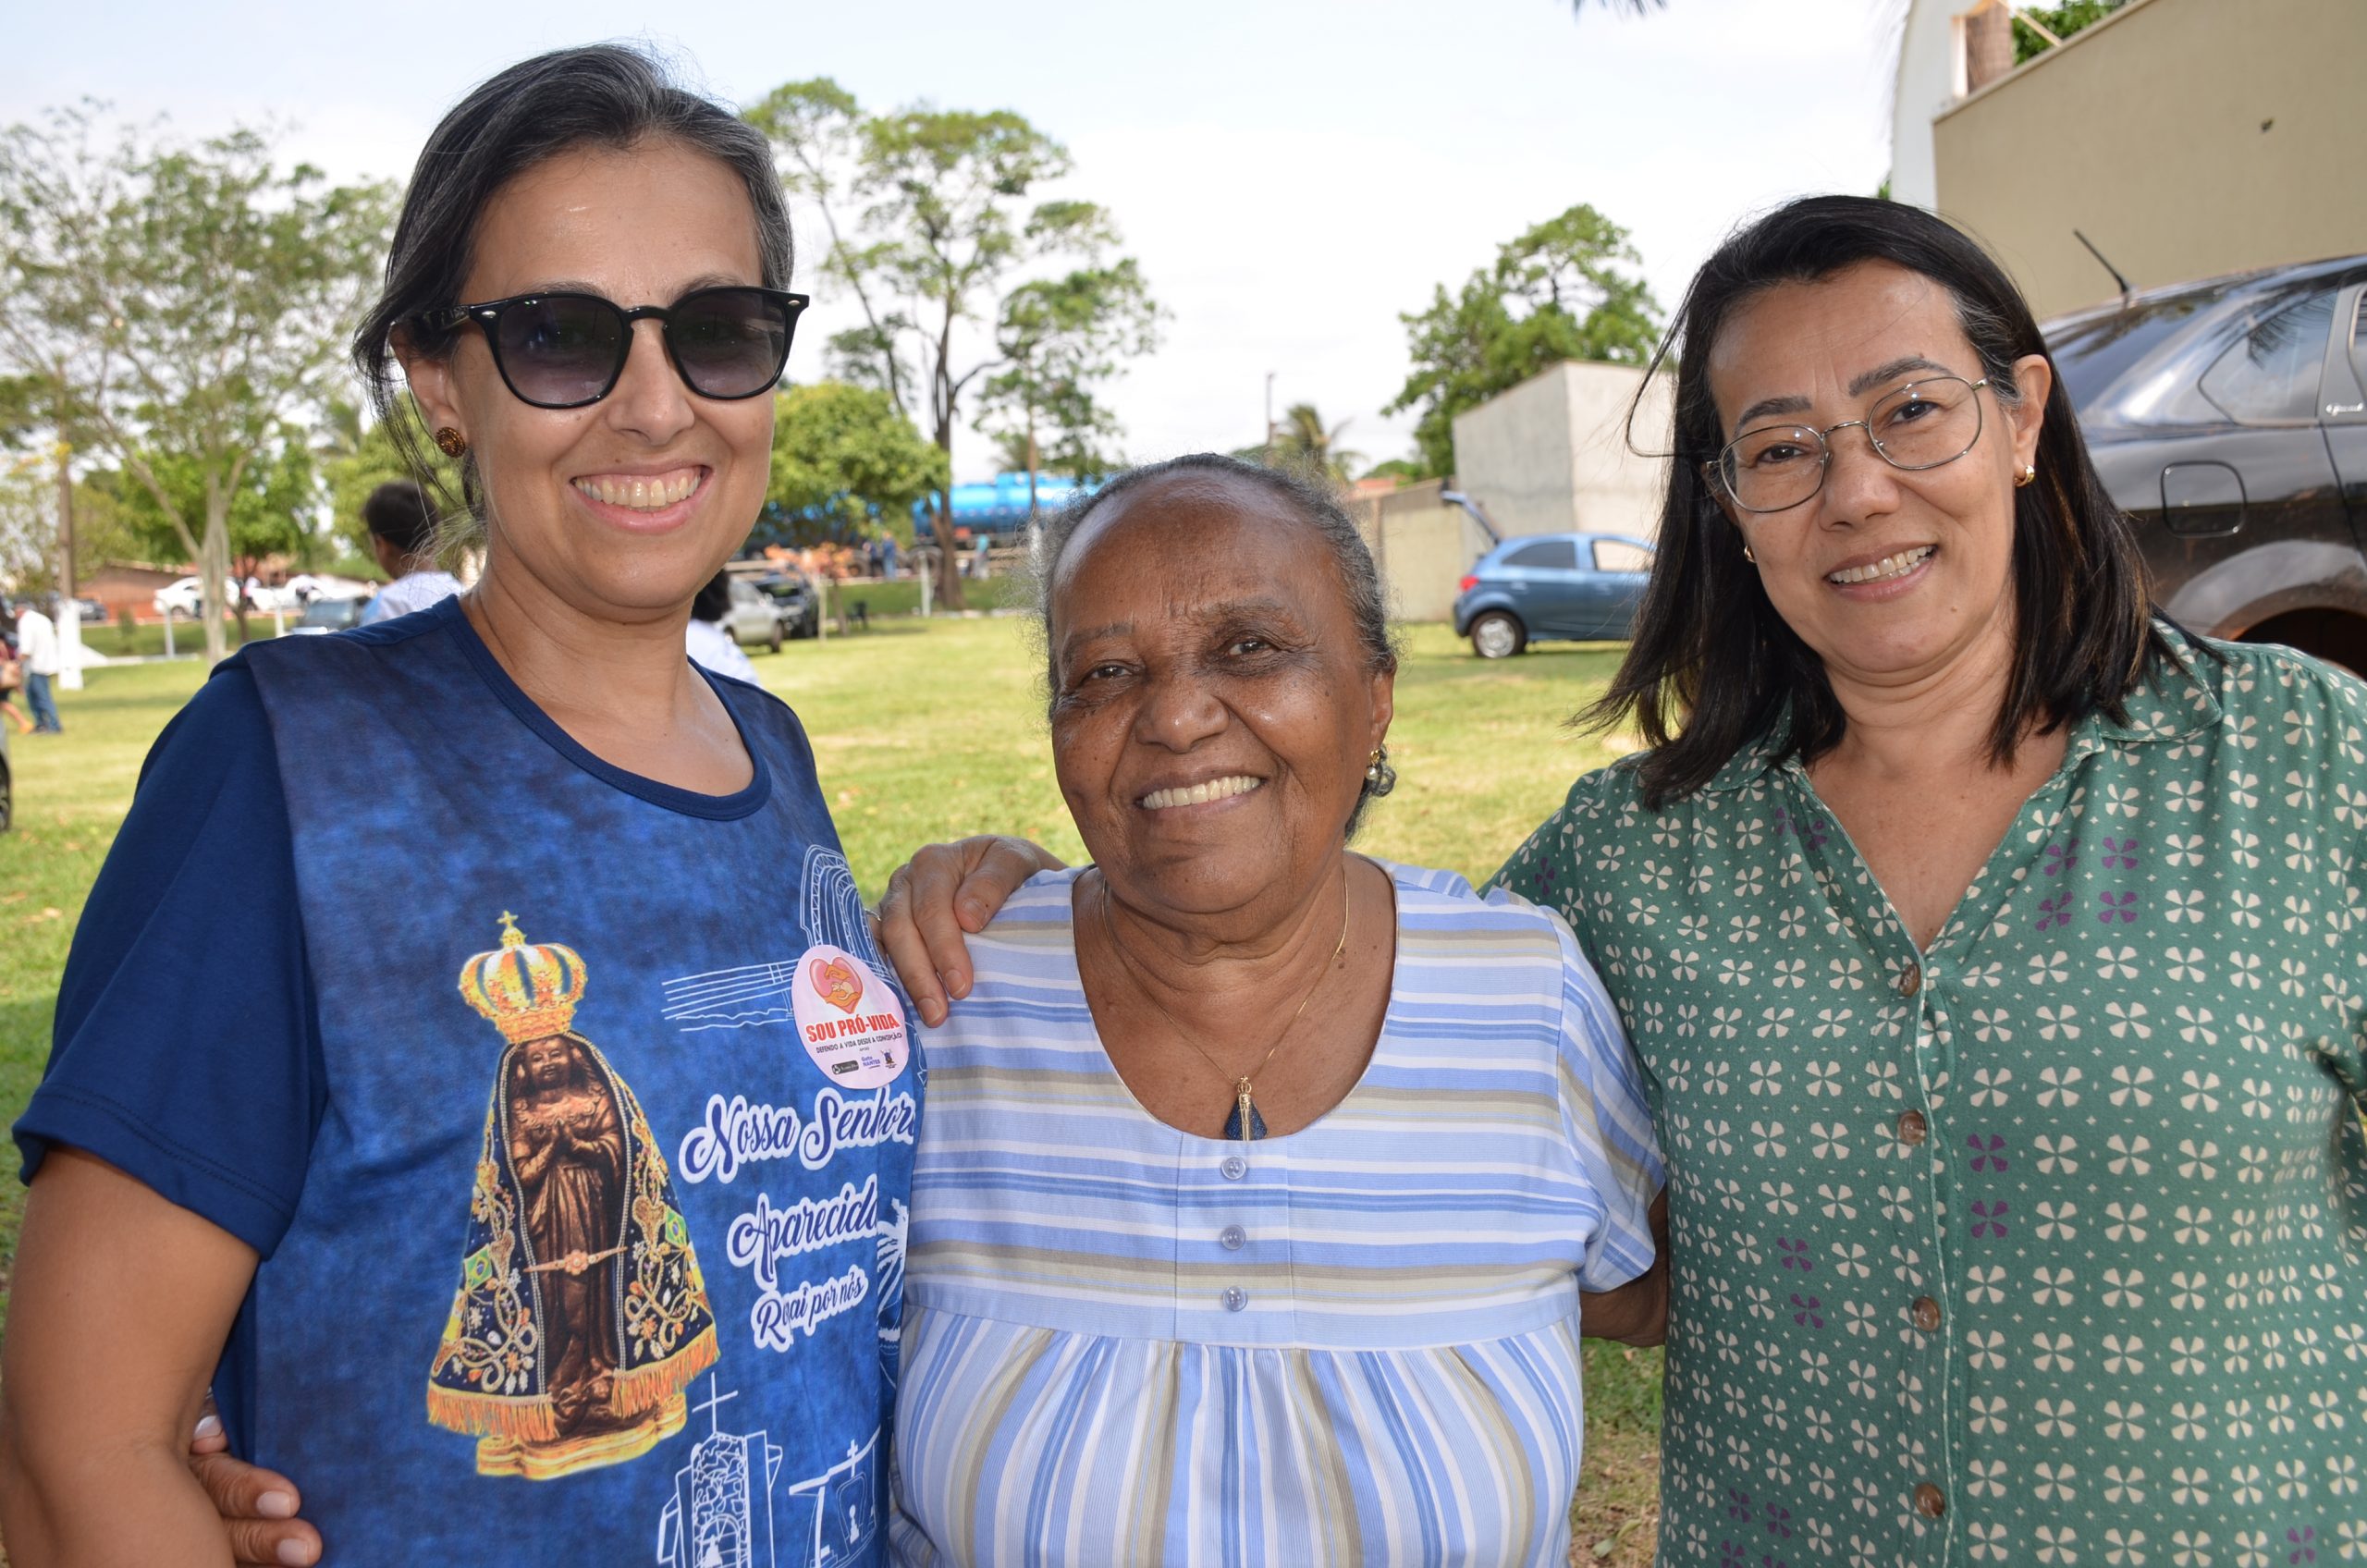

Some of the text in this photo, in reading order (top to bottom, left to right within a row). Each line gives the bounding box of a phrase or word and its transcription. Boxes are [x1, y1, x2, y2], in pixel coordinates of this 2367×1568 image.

[805, 1014, 901, 1043] SOU PRÓ-VIDA
[816, 1044, 839, 1054] DEFENDO
[844, 1040, 857, 1048] VIDA
[858, 1037, 872, 1046] DESDE
[682, 1100, 797, 1177] Nossa
[807, 1284, 838, 1328] por
[839, 1270, 865, 1305] nós
